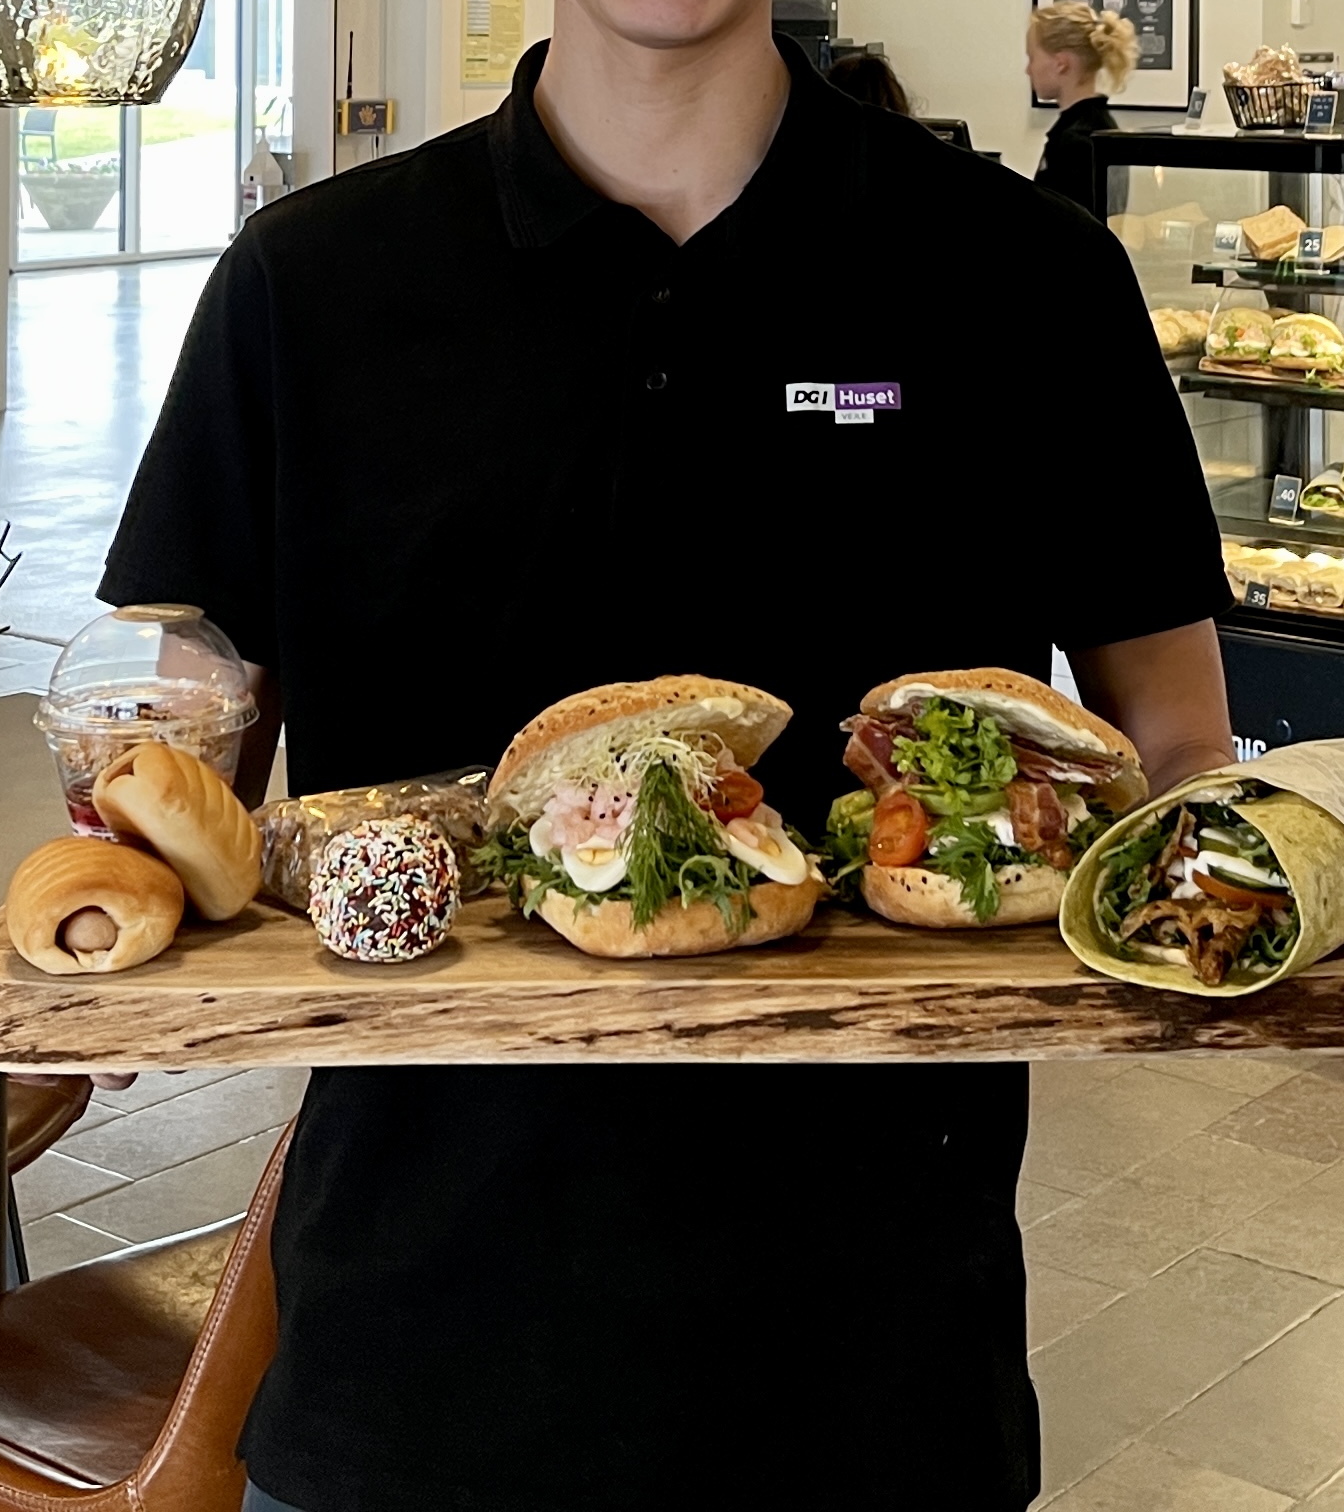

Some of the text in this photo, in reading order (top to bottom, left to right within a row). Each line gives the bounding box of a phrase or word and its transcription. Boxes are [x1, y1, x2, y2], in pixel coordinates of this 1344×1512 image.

[1304, 239, 1320, 252] 25
[793, 389, 895, 405] DGI Huset
[1280, 489, 1296, 502] 40
